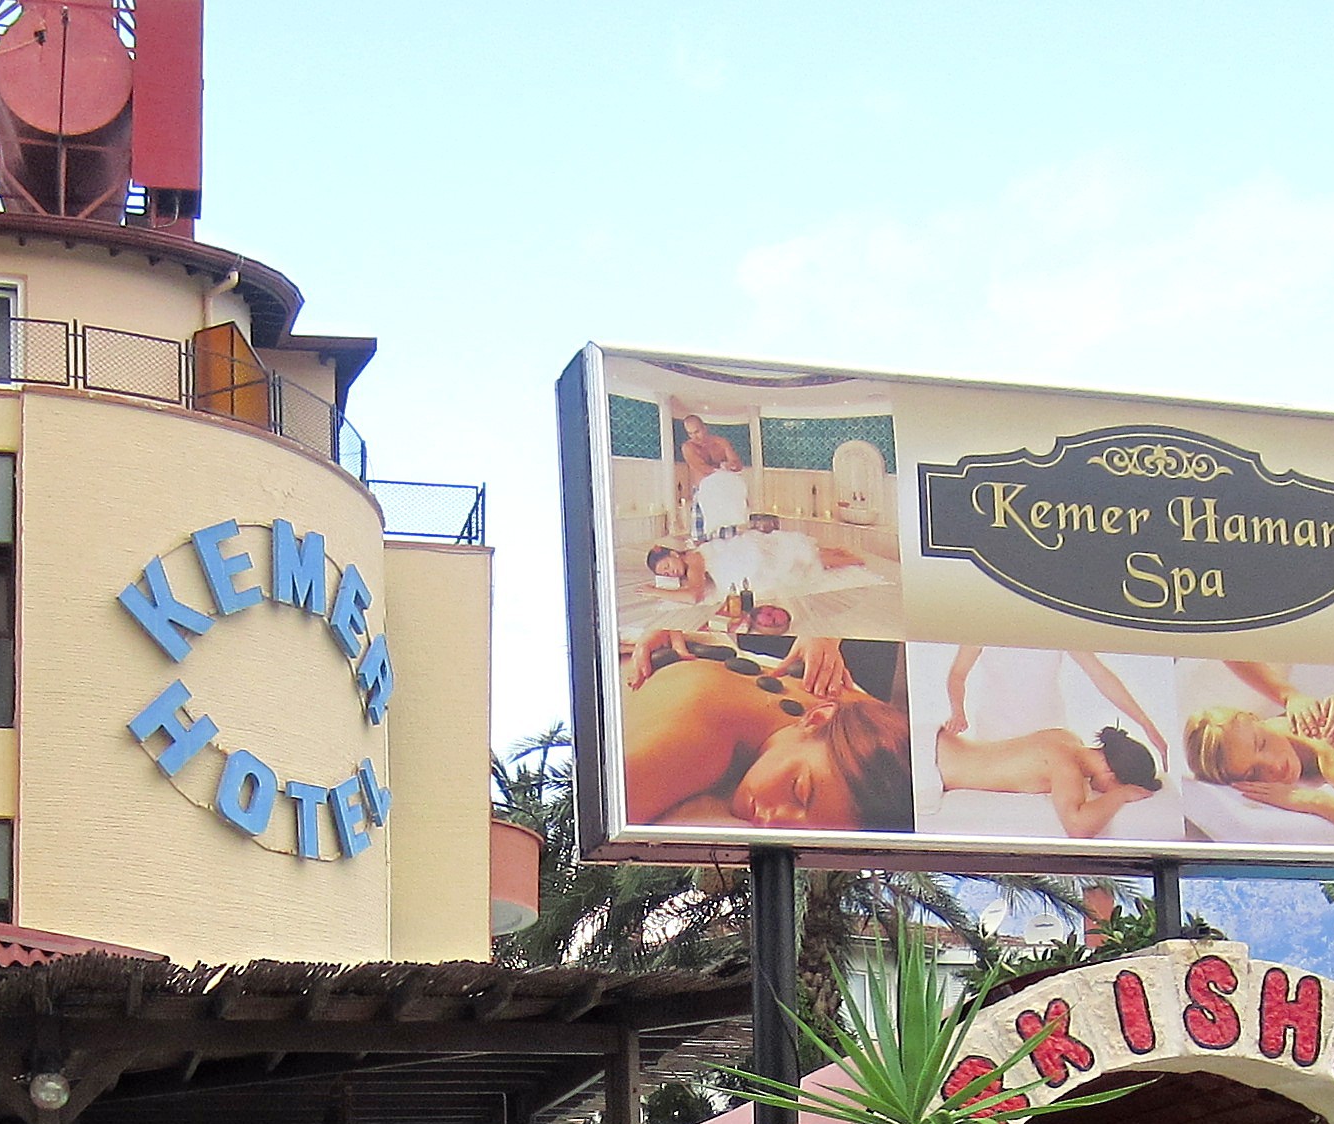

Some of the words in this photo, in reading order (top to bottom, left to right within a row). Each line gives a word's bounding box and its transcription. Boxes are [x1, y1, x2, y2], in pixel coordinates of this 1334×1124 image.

[971, 481, 1151, 551] Kemer
[116, 517, 395, 726] KEMER
[1121, 552, 1226, 613] Spa
[127, 679, 393, 860] HOTEL
